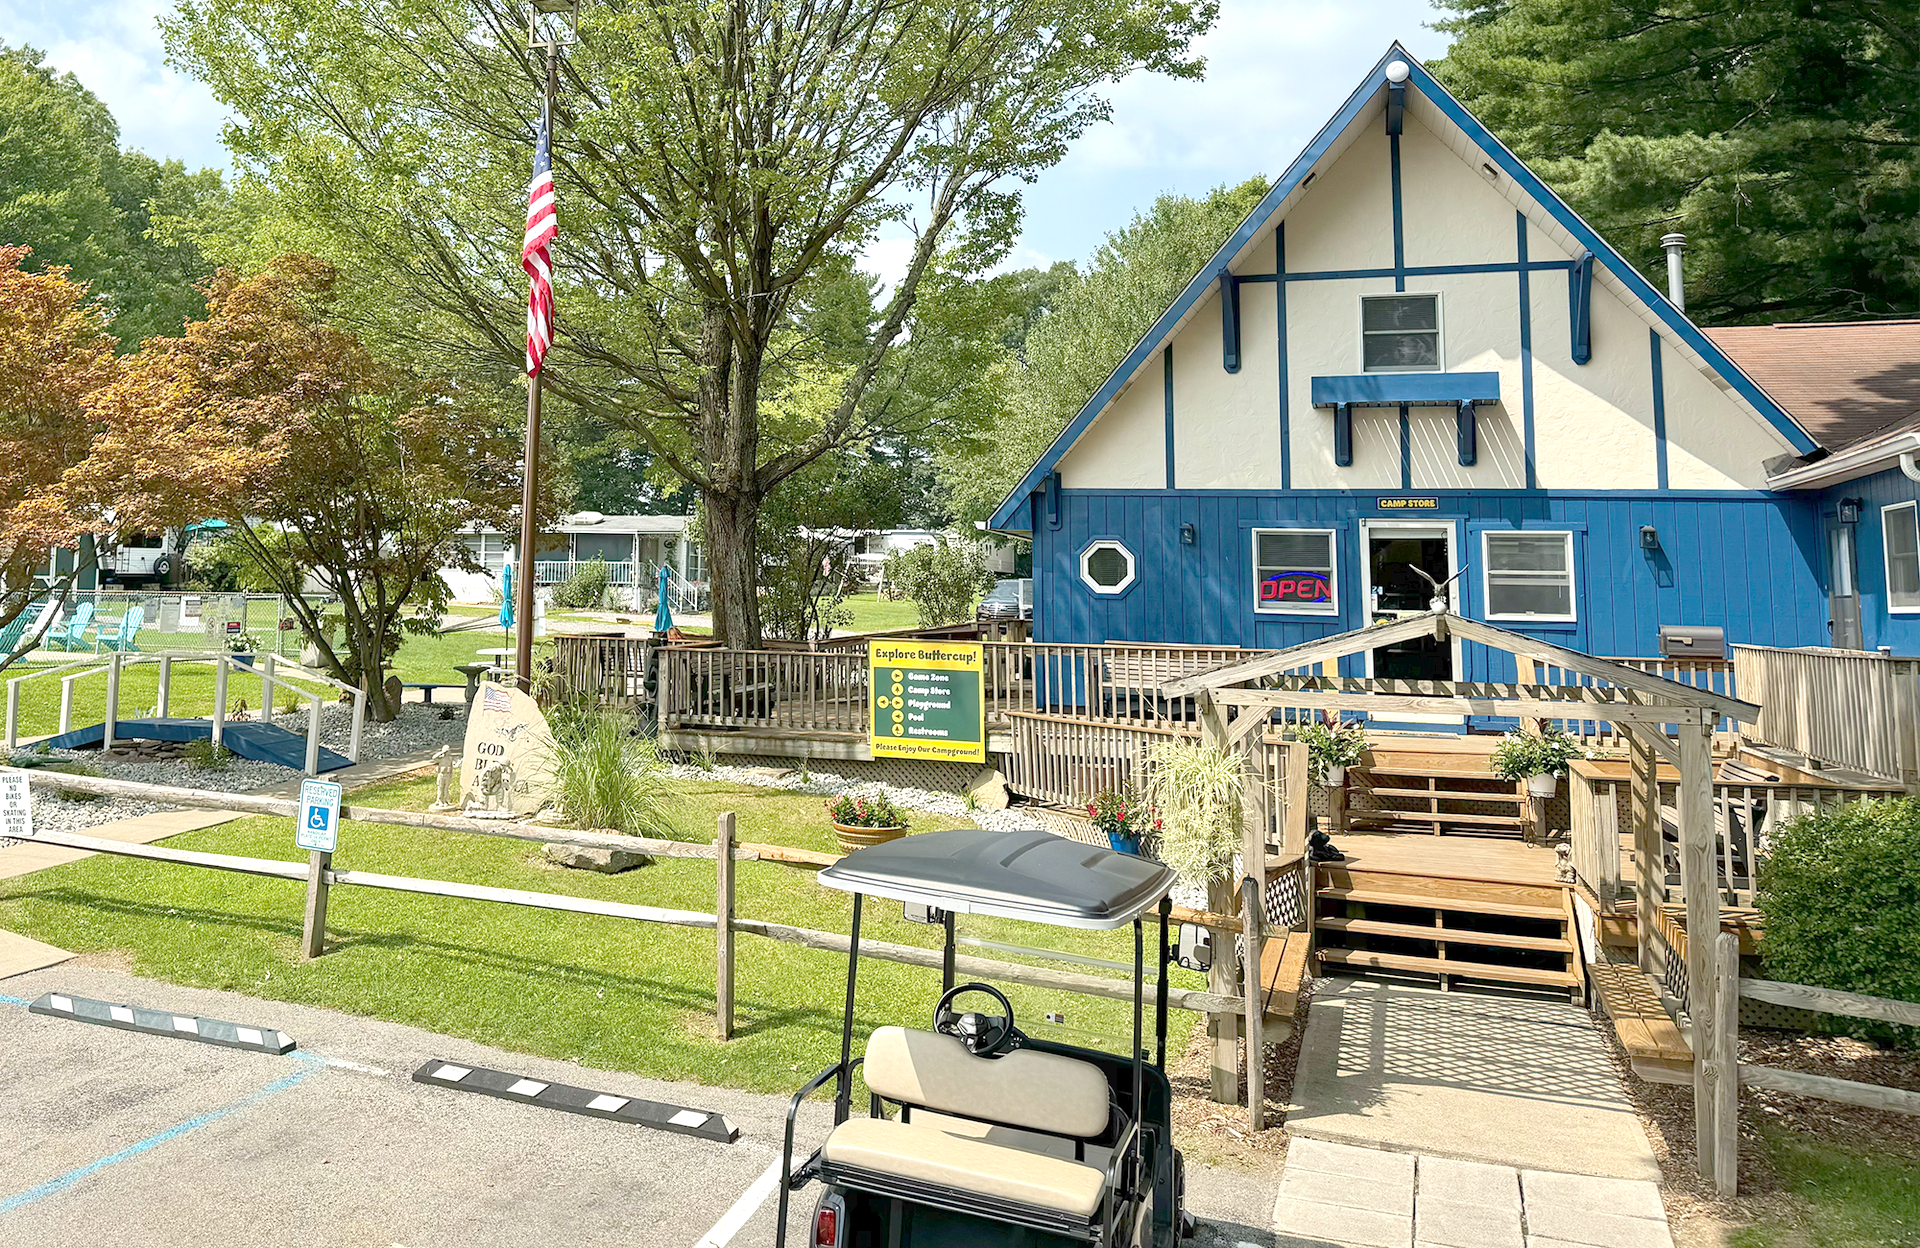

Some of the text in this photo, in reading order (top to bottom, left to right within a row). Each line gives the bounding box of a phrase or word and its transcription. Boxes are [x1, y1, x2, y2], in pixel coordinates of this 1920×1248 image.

[1380, 499, 1436, 508] CAMP STORE
[1261, 580, 1331, 599] OPEN
[875, 648, 977, 665] Explore Buttercup!
[908, 672, 949, 682] Game Zone
[908, 685, 951, 696] Camp Store
[908, 699, 951, 711] Playground
[908, 713, 924, 721] Pool
[908, 726, 949, 737] Restrooms
[477, 741, 505, 756] GOD
[875, 743, 980, 757] Please Enjoy Our Campground!
[305, 786, 337, 797] RESERVED
[306, 796, 334, 806] PARKING
